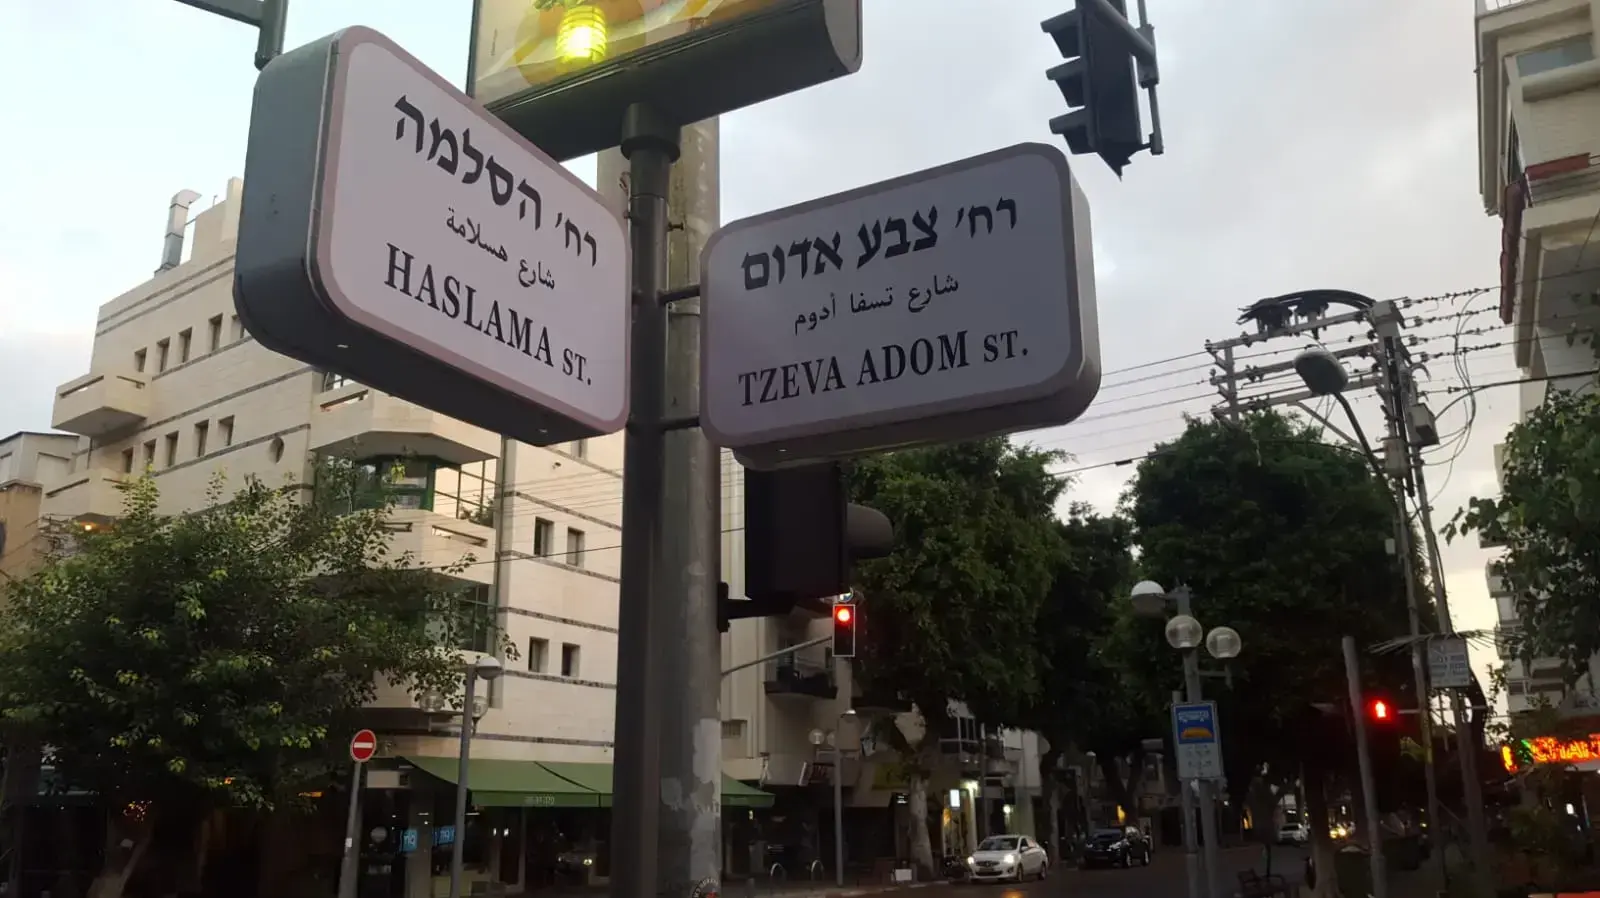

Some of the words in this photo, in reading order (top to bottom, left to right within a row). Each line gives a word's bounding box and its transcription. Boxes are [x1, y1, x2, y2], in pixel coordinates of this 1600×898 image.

[394, 95, 542, 231] הסלמה
[445, 207, 508, 262] هسلامة
[741, 231, 844, 291] אדום
[856, 205, 938, 269] צבע
[518, 259, 555, 290] شارع
[850, 286, 894, 314] تسفا
[907, 275, 959, 313] شارع
[384, 242, 554, 368] HASLAMA
[562, 348, 592, 386] ST.
[794, 292, 836, 336] أدوم
[737, 355, 847, 407] TZEVA
[856, 330, 969, 386] ADOM
[983, 330, 1029, 363] ST.
